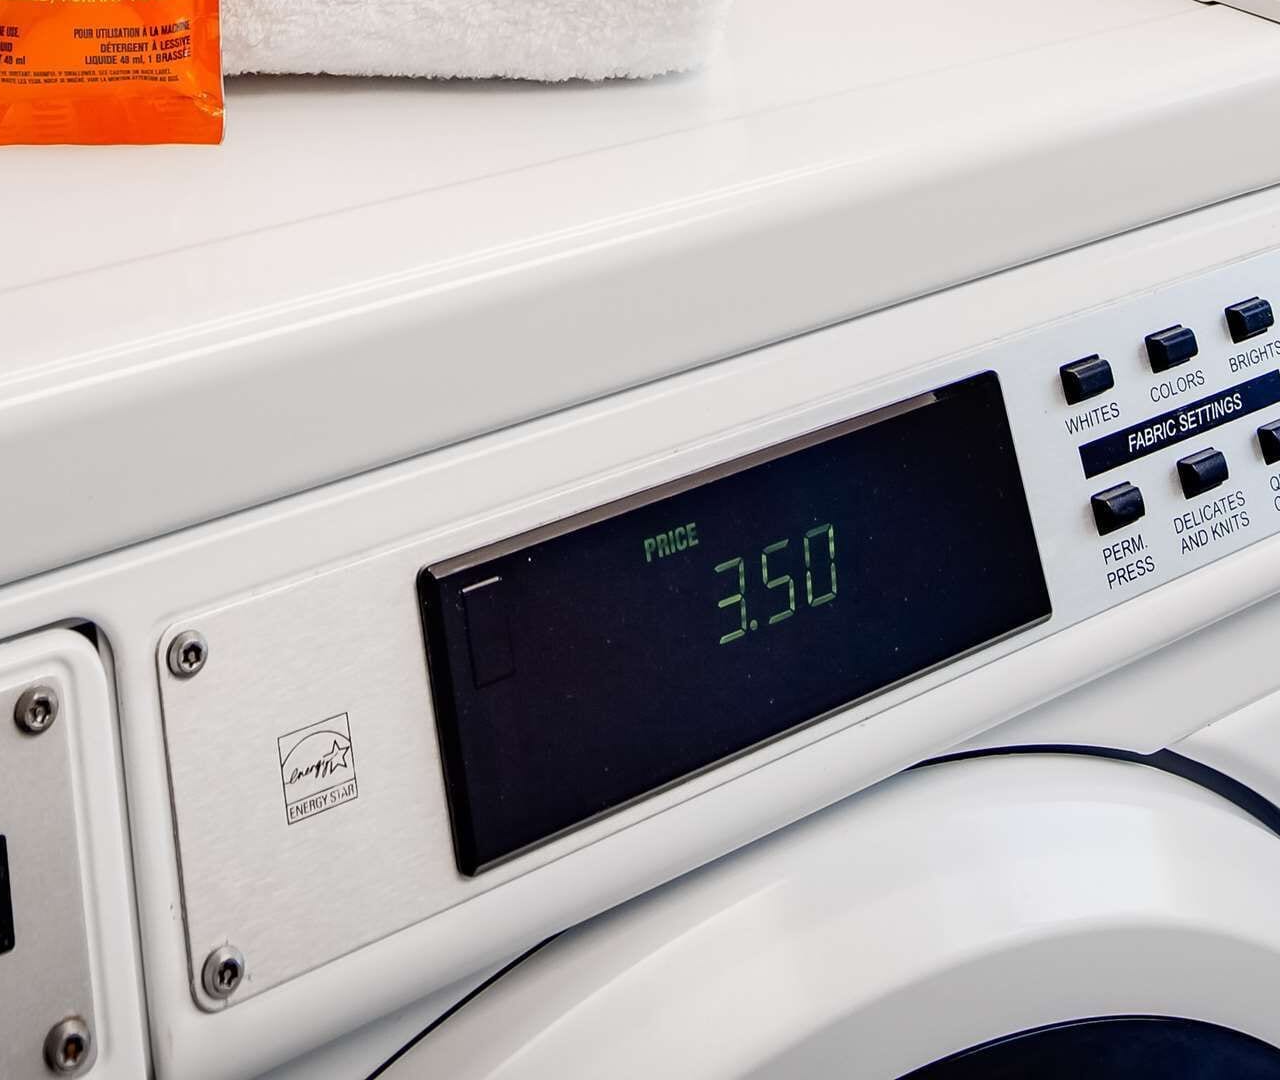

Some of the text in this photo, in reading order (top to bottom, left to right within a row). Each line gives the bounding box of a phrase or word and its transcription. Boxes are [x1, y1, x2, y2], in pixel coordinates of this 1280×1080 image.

[73, 28, 94, 39] POUR
[95, 27, 140, 39] UTILISATION
[149, 25, 159, 37] LA
[160, 20, 190, 35] MACHINE
[100, 41, 149, 53] DÉTERGENT
[160, 35, 191, 51] LESSIVE
[85, 55, 118, 66] LIQUIDE
[155, 47, 192, 63] BRASSÉE
[1149, 369, 1206, 403] COLORS
[1064, 402, 1121, 435] WHITES
[1128, 393, 1243, 453] FABRIC SETTINGS
[1173, 490, 1247, 534] DELICATES
[643, 522, 699, 563] PRICE
[1102, 534, 1149, 565] PERM.
[1180, 511, 1251, 555] AND KNITS
[714, 522, 838, 645] 3.50
[1106, 555, 1156, 590] PRESS
[289, 783, 355, 820] ENERGY STAR
